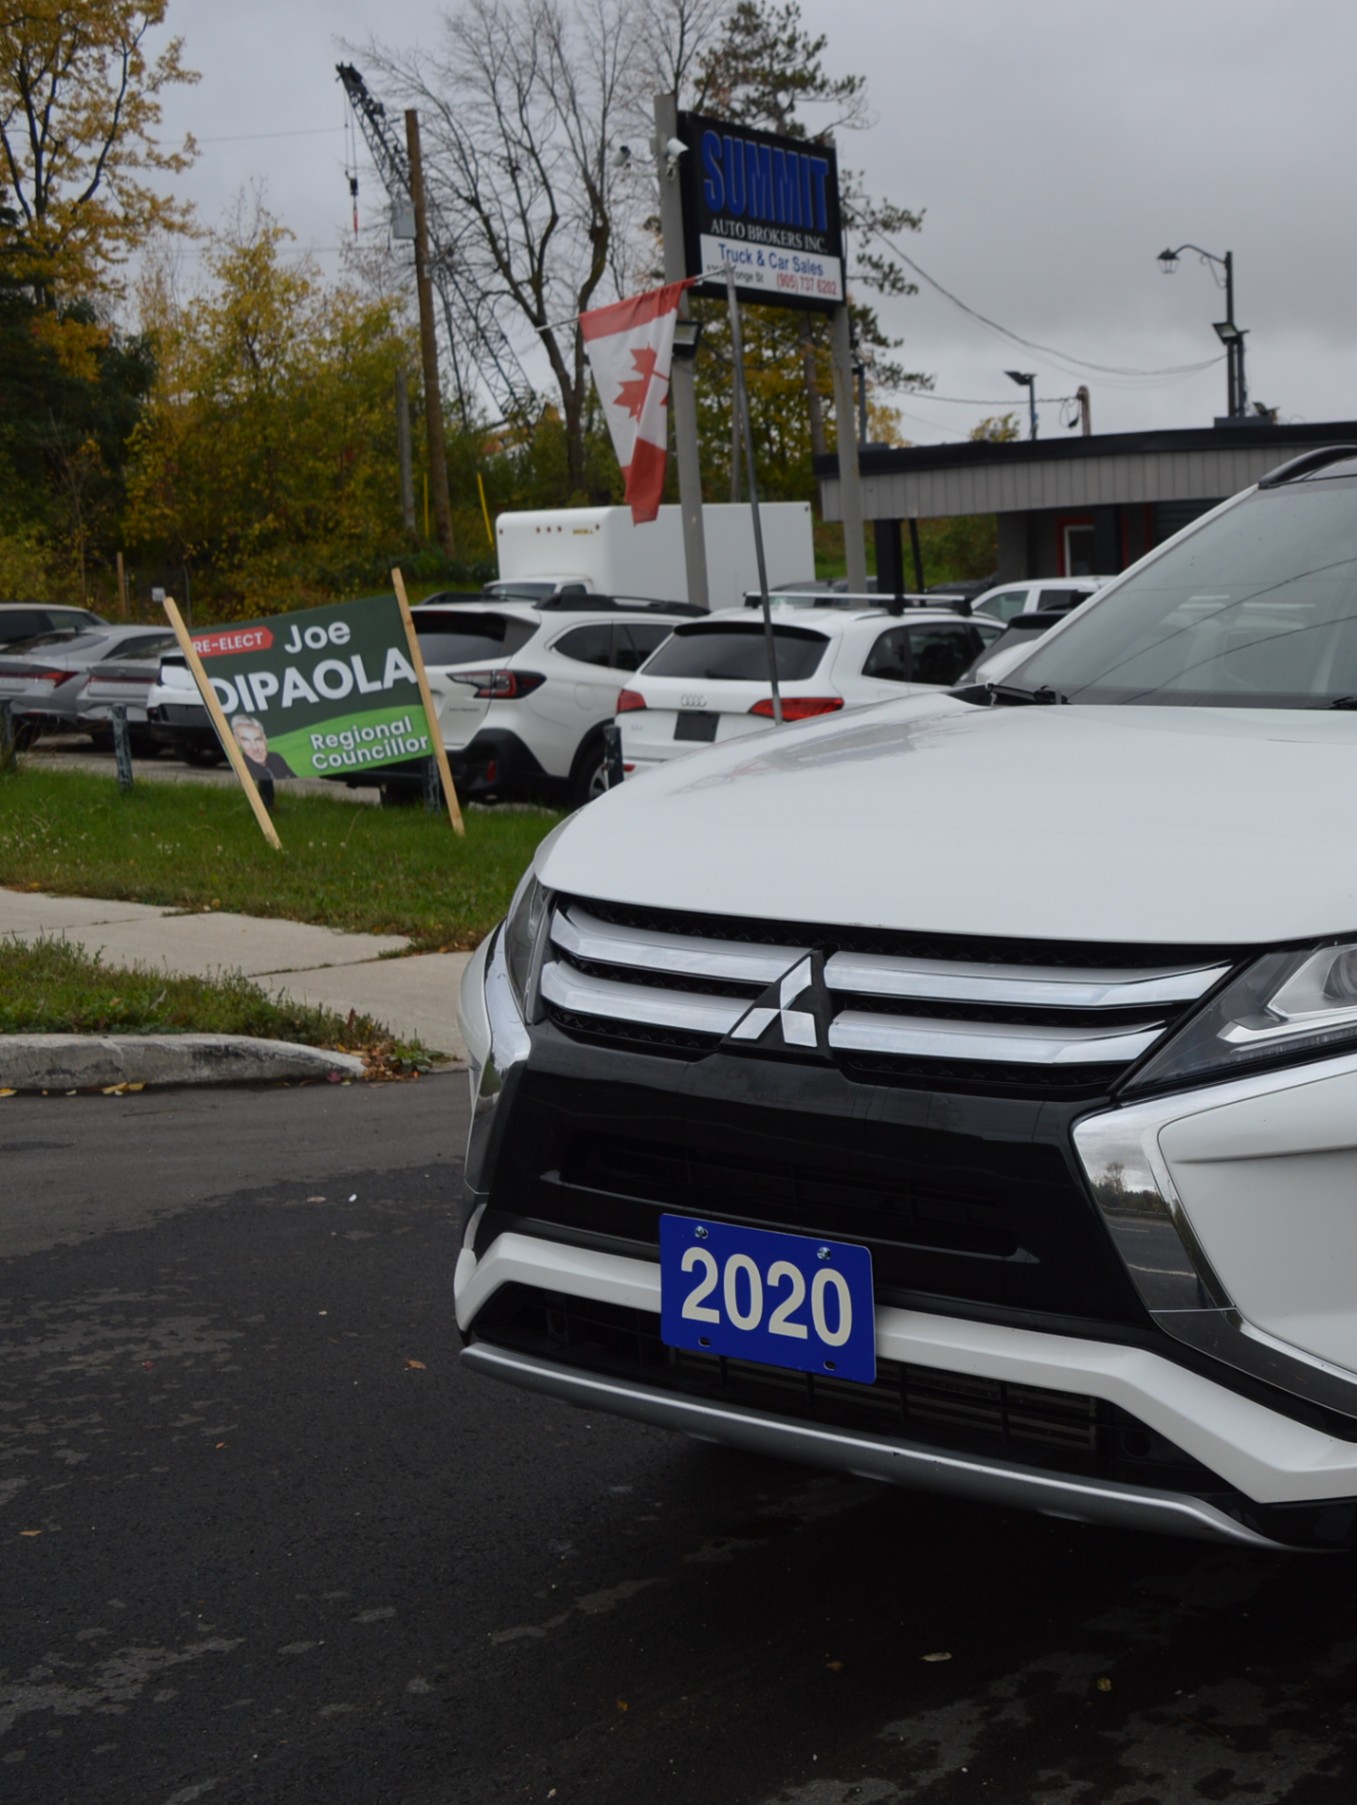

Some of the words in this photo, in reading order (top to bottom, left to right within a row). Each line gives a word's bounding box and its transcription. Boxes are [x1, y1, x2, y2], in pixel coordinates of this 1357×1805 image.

[703, 130, 829, 232] SUMMIT
[711, 218, 746, 239] AUTO
[747, 224, 803, 249] BROKERS
[804, 235, 828, 254] INC.
[718, 243, 754, 265] Truck
[756, 250, 765, 267] &
[768, 252, 789, 271] Car
[792, 255, 824, 277] Sales
[193, 631, 264, 654] RE-ELECT
[284, 621, 351, 654] Joe
[208, 647, 418, 714] DIPAOLA
[310, 715, 412, 753] Regional
[311, 736, 429, 770] Councillor
[681, 1246, 853, 1347] 2020
